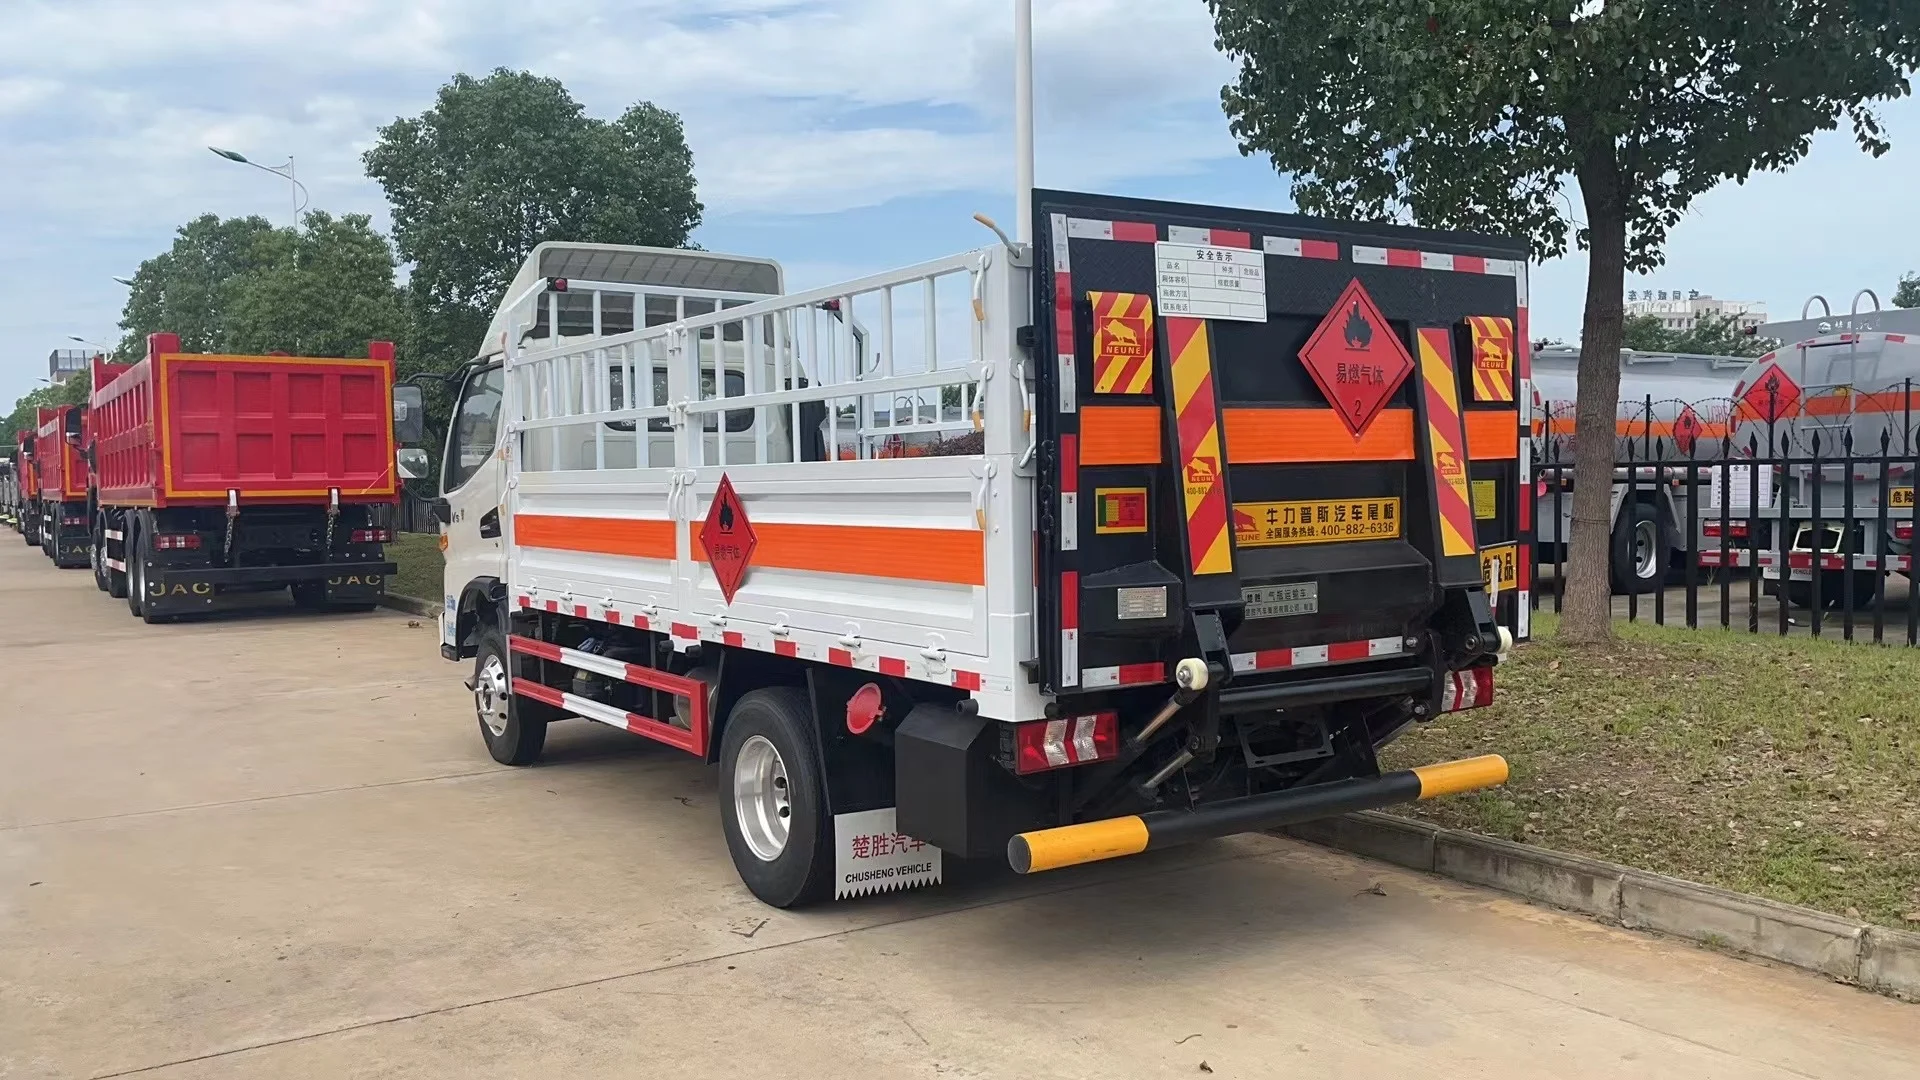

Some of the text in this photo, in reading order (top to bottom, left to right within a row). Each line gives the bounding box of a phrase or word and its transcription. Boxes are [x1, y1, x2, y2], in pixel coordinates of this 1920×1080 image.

[1196, 249, 1233, 262] 安全告示
[1166, 261, 1180, 270] 品名
[1162, 302, 1188, 312] 联系电话
[1106, 345, 1141, 356] NEUNE
[1480, 360, 1505, 370] NEUNE
[1336, 362, 1384, 387] 易燃气体
[1354, 399, 1362, 417] 2
[1266, 502, 1394, 525] 牛力普斯汽车尾板
[328, 574, 381, 586] JAC
[150, 582, 211, 597] JAC
[852, 831, 926, 860] 楚胜汽车
[845, 862, 932, 884] CHUSHENG VEHICLE
